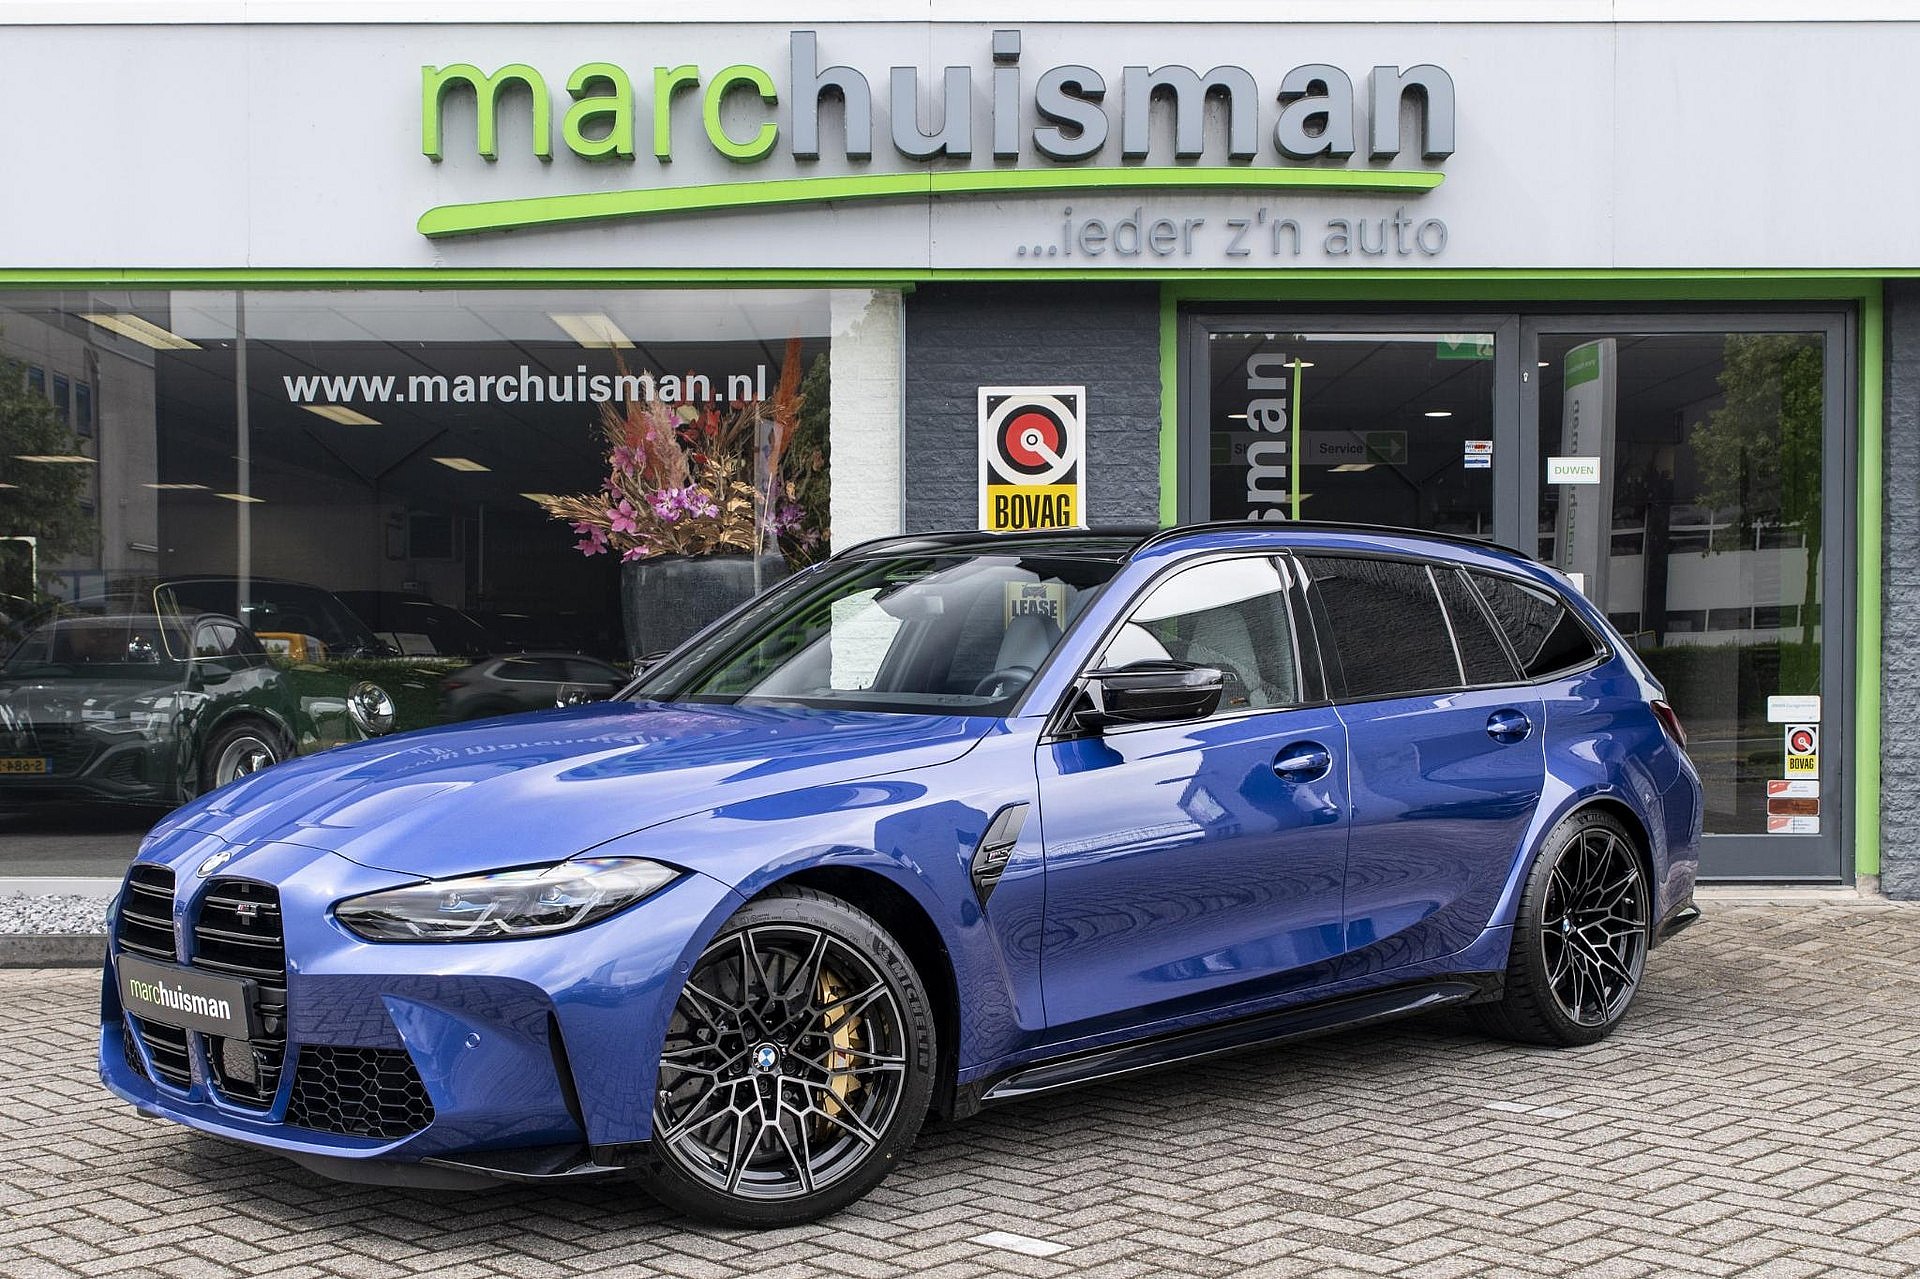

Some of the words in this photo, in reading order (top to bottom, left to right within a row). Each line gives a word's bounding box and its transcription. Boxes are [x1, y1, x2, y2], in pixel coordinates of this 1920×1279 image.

[421, 30, 1456, 164] marchuisman
[1224, 207, 1302, 257] z'n
[1323, 206, 1449, 257] auto
[283, 365, 767, 403] www.marchuisman.nl
[1319, 442, 1364, 454] Service
[1554, 466, 1594, 475] DUWEN
[995, 493, 1071, 530] BOVAG
[1011, 599, 1058, 617] LEASE
[1789, 757, 1815, 770] BOVAG
[130, 979, 231, 1020] marchuisman
[890, 960, 929, 1069] MICHELIN
